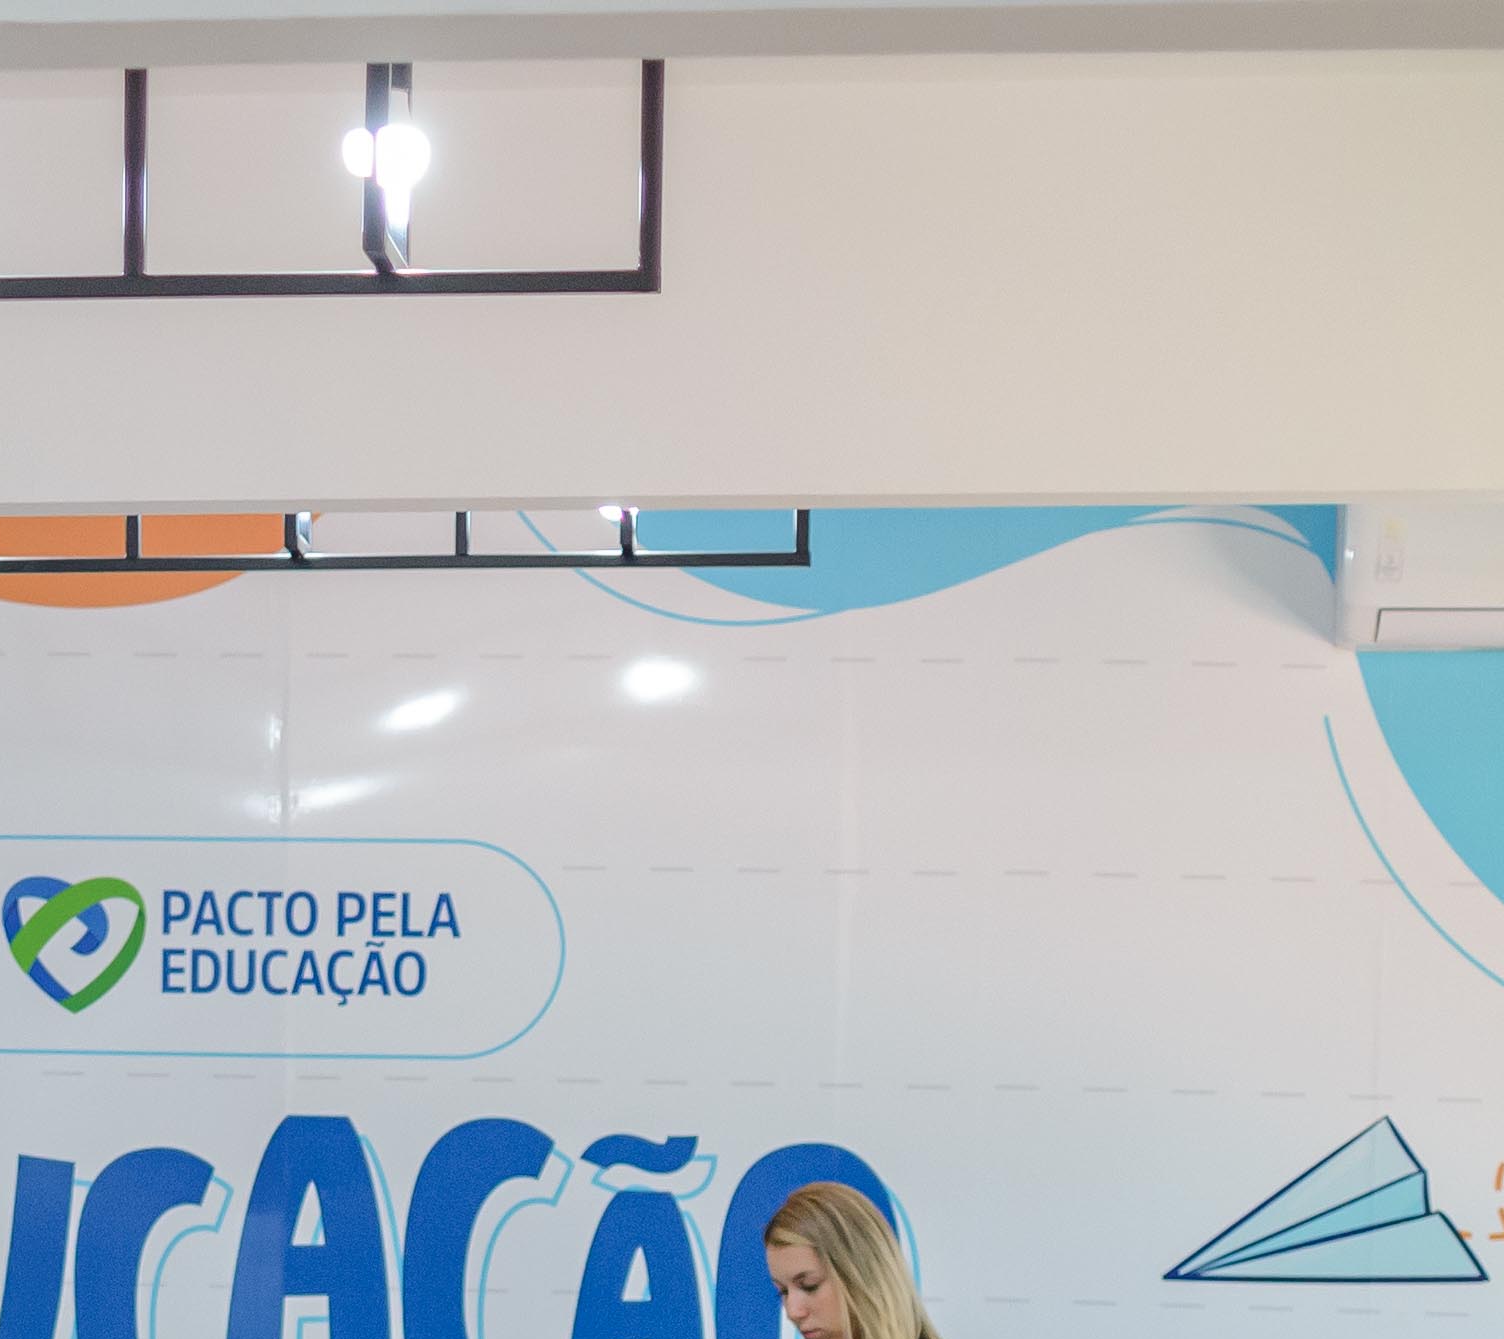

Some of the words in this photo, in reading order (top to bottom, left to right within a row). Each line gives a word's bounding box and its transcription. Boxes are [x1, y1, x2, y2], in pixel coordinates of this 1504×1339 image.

[161, 889, 319, 937] PACTO
[335, 891, 462, 939] PELA
[161, 941, 428, 1006] EDUCAÇÃO
